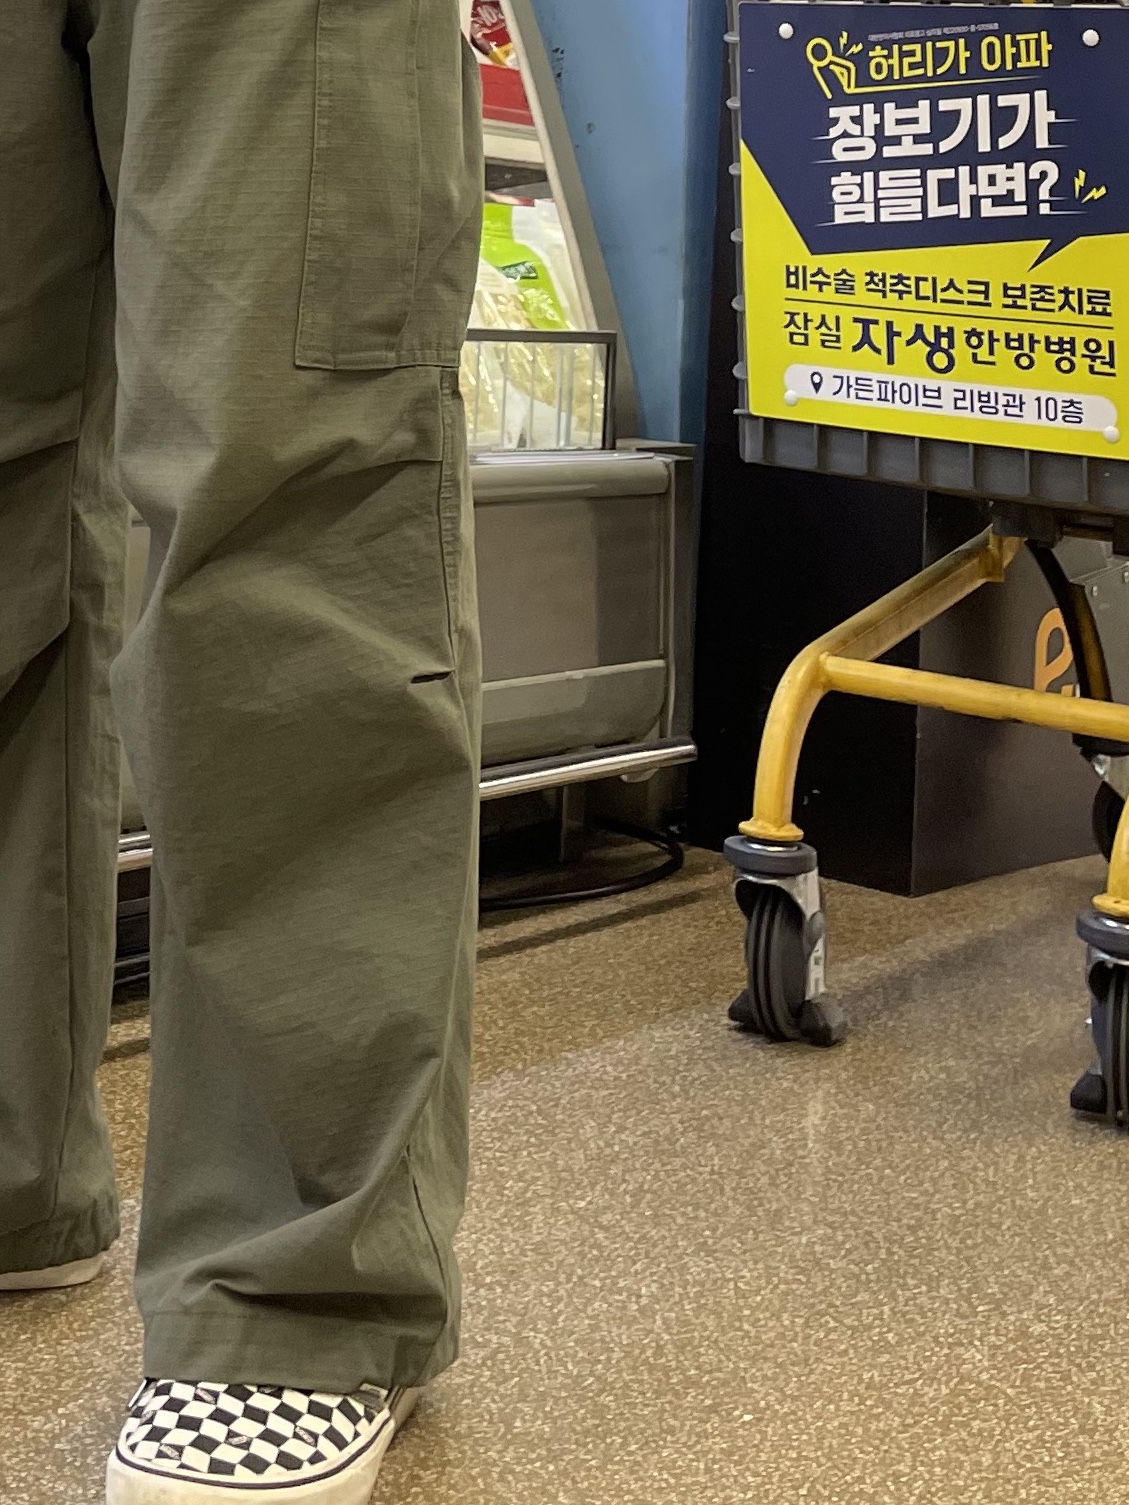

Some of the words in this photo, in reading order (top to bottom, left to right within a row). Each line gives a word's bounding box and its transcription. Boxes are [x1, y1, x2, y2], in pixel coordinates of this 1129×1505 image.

[868, 37, 971, 80] 허리가
[980, 30, 1053, 71] 아파
[829, 90, 1056, 161] 장보기가
[830, 160, 1060, 224] 힘들다면?
[785, 264, 856, 295] 비수술
[864, 270, 992, 307] 척추디스크
[1002, 282, 1113, 317] 보존치료
[783, 311, 842, 349] 잠실
[852, 316, 1117, 377] 자생한방병원
[833, 373, 944, 409] 가든파이브
[953, 388, 1026, 418] 리빙관
[1034, 395, 1084, 424] 10층
